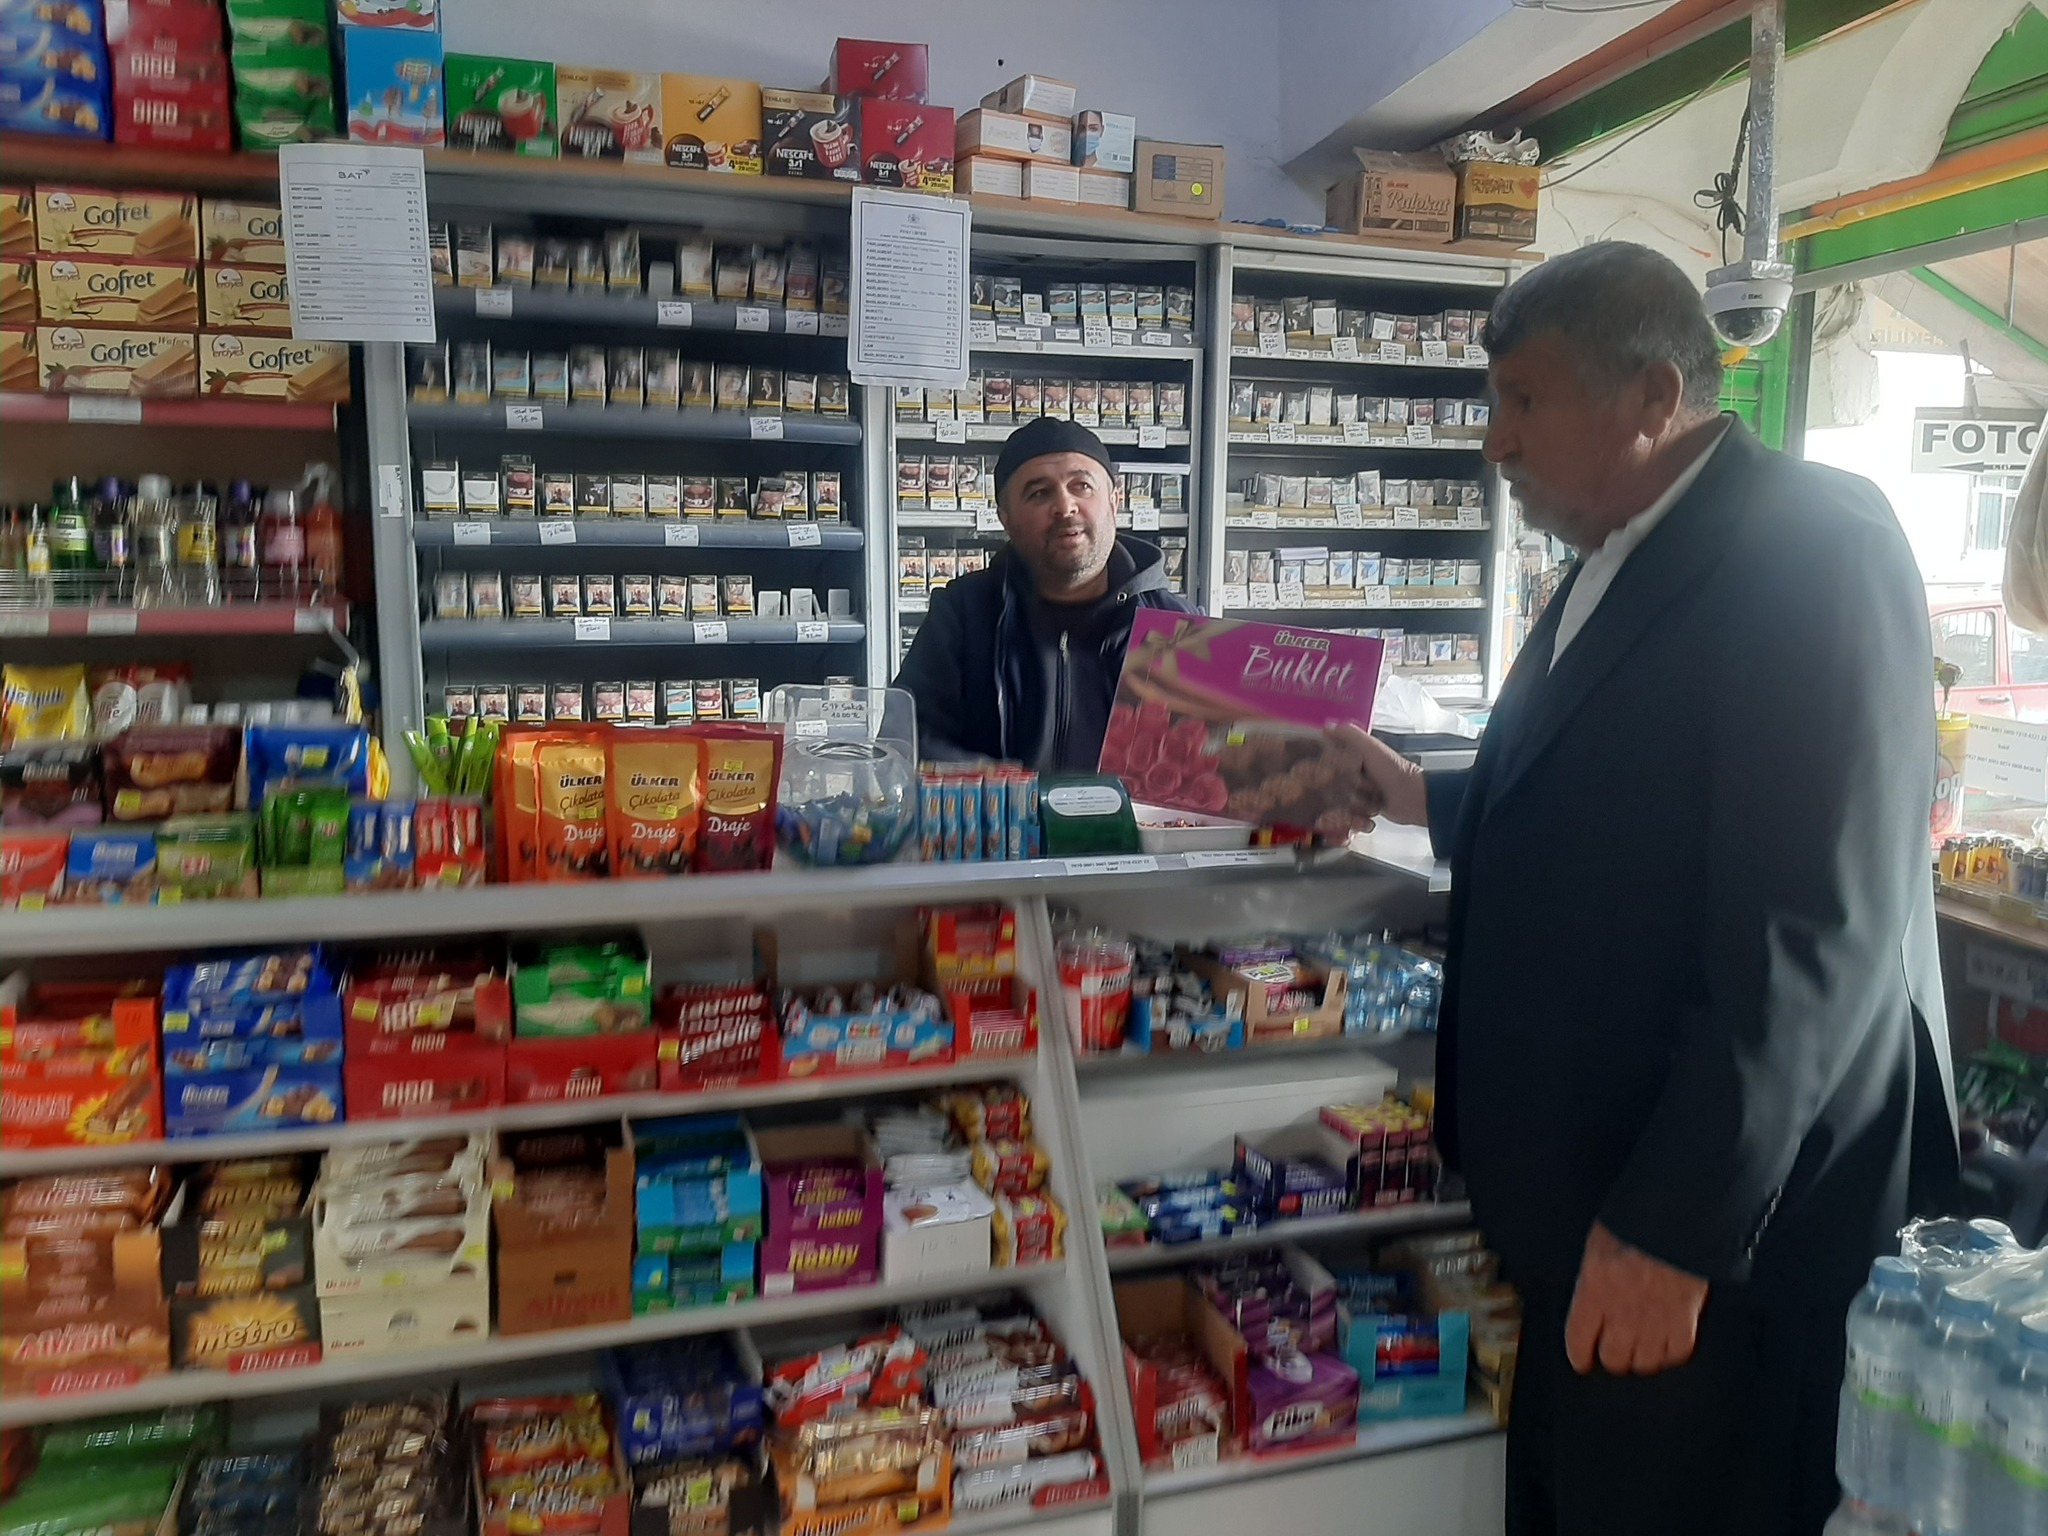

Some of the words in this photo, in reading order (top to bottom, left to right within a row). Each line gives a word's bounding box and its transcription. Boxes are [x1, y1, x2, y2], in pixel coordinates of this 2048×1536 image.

[84, 202, 151, 229] Gofret
[88, 269, 156, 296] Gofret
[90, 339, 158, 365] Gofret
[249, 346, 314, 371] Gofret
[1274, 630, 1330, 651] ÜLKER
[1243, 645, 1353, 687] Buklet
[560, 774, 602, 789] ÜLKER
[630, 773, 679, 787] ÜLKER
[707, 768, 755, 783] ÜLKER
[629, 791, 681, 809] Çikolata
[705, 786, 756, 802] Çikolata
[563, 821, 605, 844] Draje
[631, 822, 677, 845] Draje
[707, 816, 752, 834] Draje
[194, 1320, 298, 1354] metro
